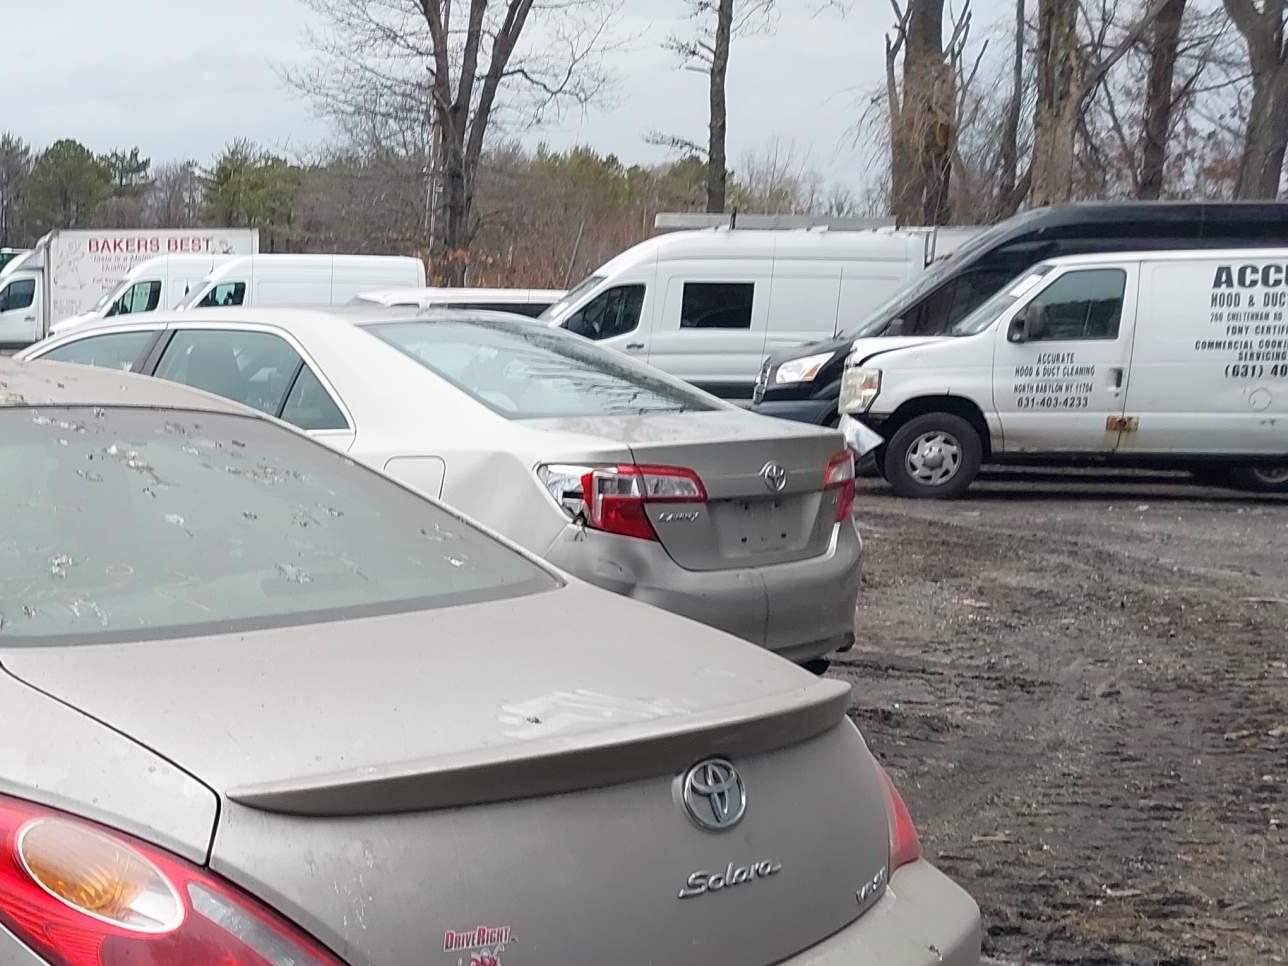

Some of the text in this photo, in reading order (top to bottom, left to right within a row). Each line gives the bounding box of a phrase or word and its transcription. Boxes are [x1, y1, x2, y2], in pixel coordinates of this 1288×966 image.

[88, 239, 213, 253] BAKERS BEST
[1211, 291, 1288, 308] HOOD & DUC
[1194, 339, 1288, 350] COMMERCIAL COOKI
[1037, 352, 1075, 364] ACCURATE
[1014, 366, 1033, 377] HOOD
[1042, 366, 1061, 377] DUCT
[1062, 366, 1095, 377] CLEANING
[1224, 364, 1264, 378] (631)
[1016, 396, 1089, 408] 631-403-4233
[677, 861, 782, 899] Solara
